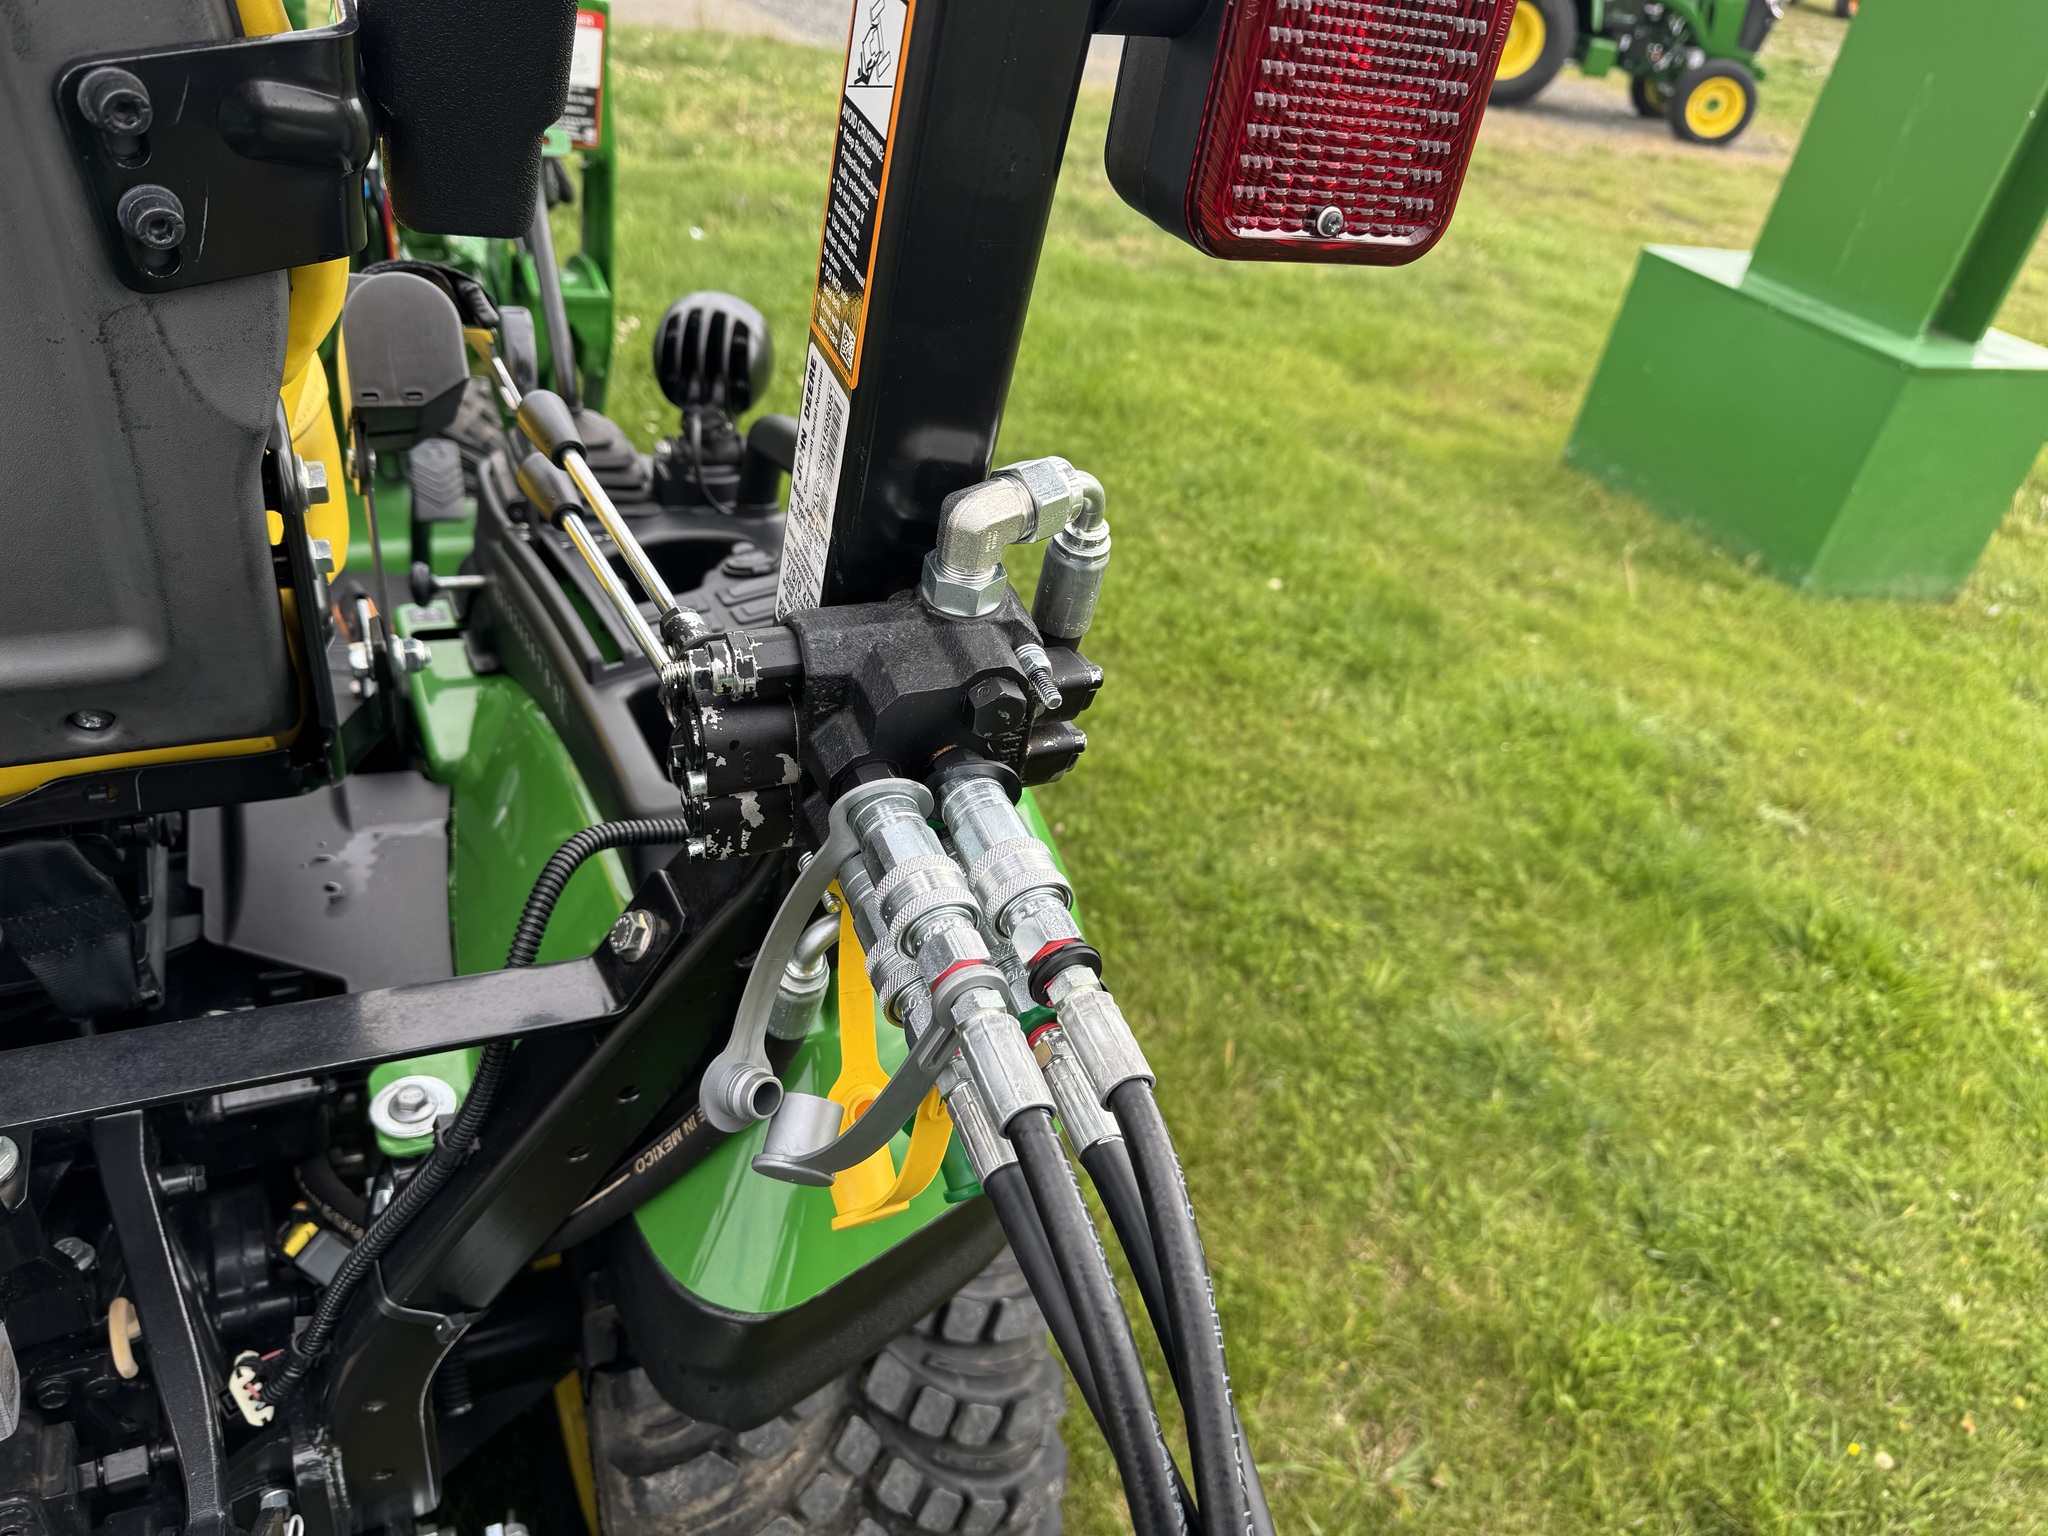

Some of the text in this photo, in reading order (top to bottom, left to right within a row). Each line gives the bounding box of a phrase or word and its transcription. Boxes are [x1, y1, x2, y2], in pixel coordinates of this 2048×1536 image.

[842, 103, 884, 162] AVOID CRUSHING:
[843, 127, 872, 169] Keep Rollover
[839, 163, 869, 210] fully extended.
[841, 145, 878, 199] Protective Structure
[834, 200, 860, 240] machine tips.
[836, 180, 865, 224] Do not jump if
[824, 242, 829, 258] be
[826, 226, 865, 289] When structure must
[832, 214, 857, 258] Use seat belt.
[823, 283, 832, 300] seat
[825, 264, 849, 304] DO NOT use
[821, 297, 840, 332] Drive with
[799, 355, 818, 481] JOHN DEERE
[803, 366, 824, 494] Component Serial Number
[683, 1114, 698, 1135] IN
[634, 1127, 684, 1174] MEXICO
